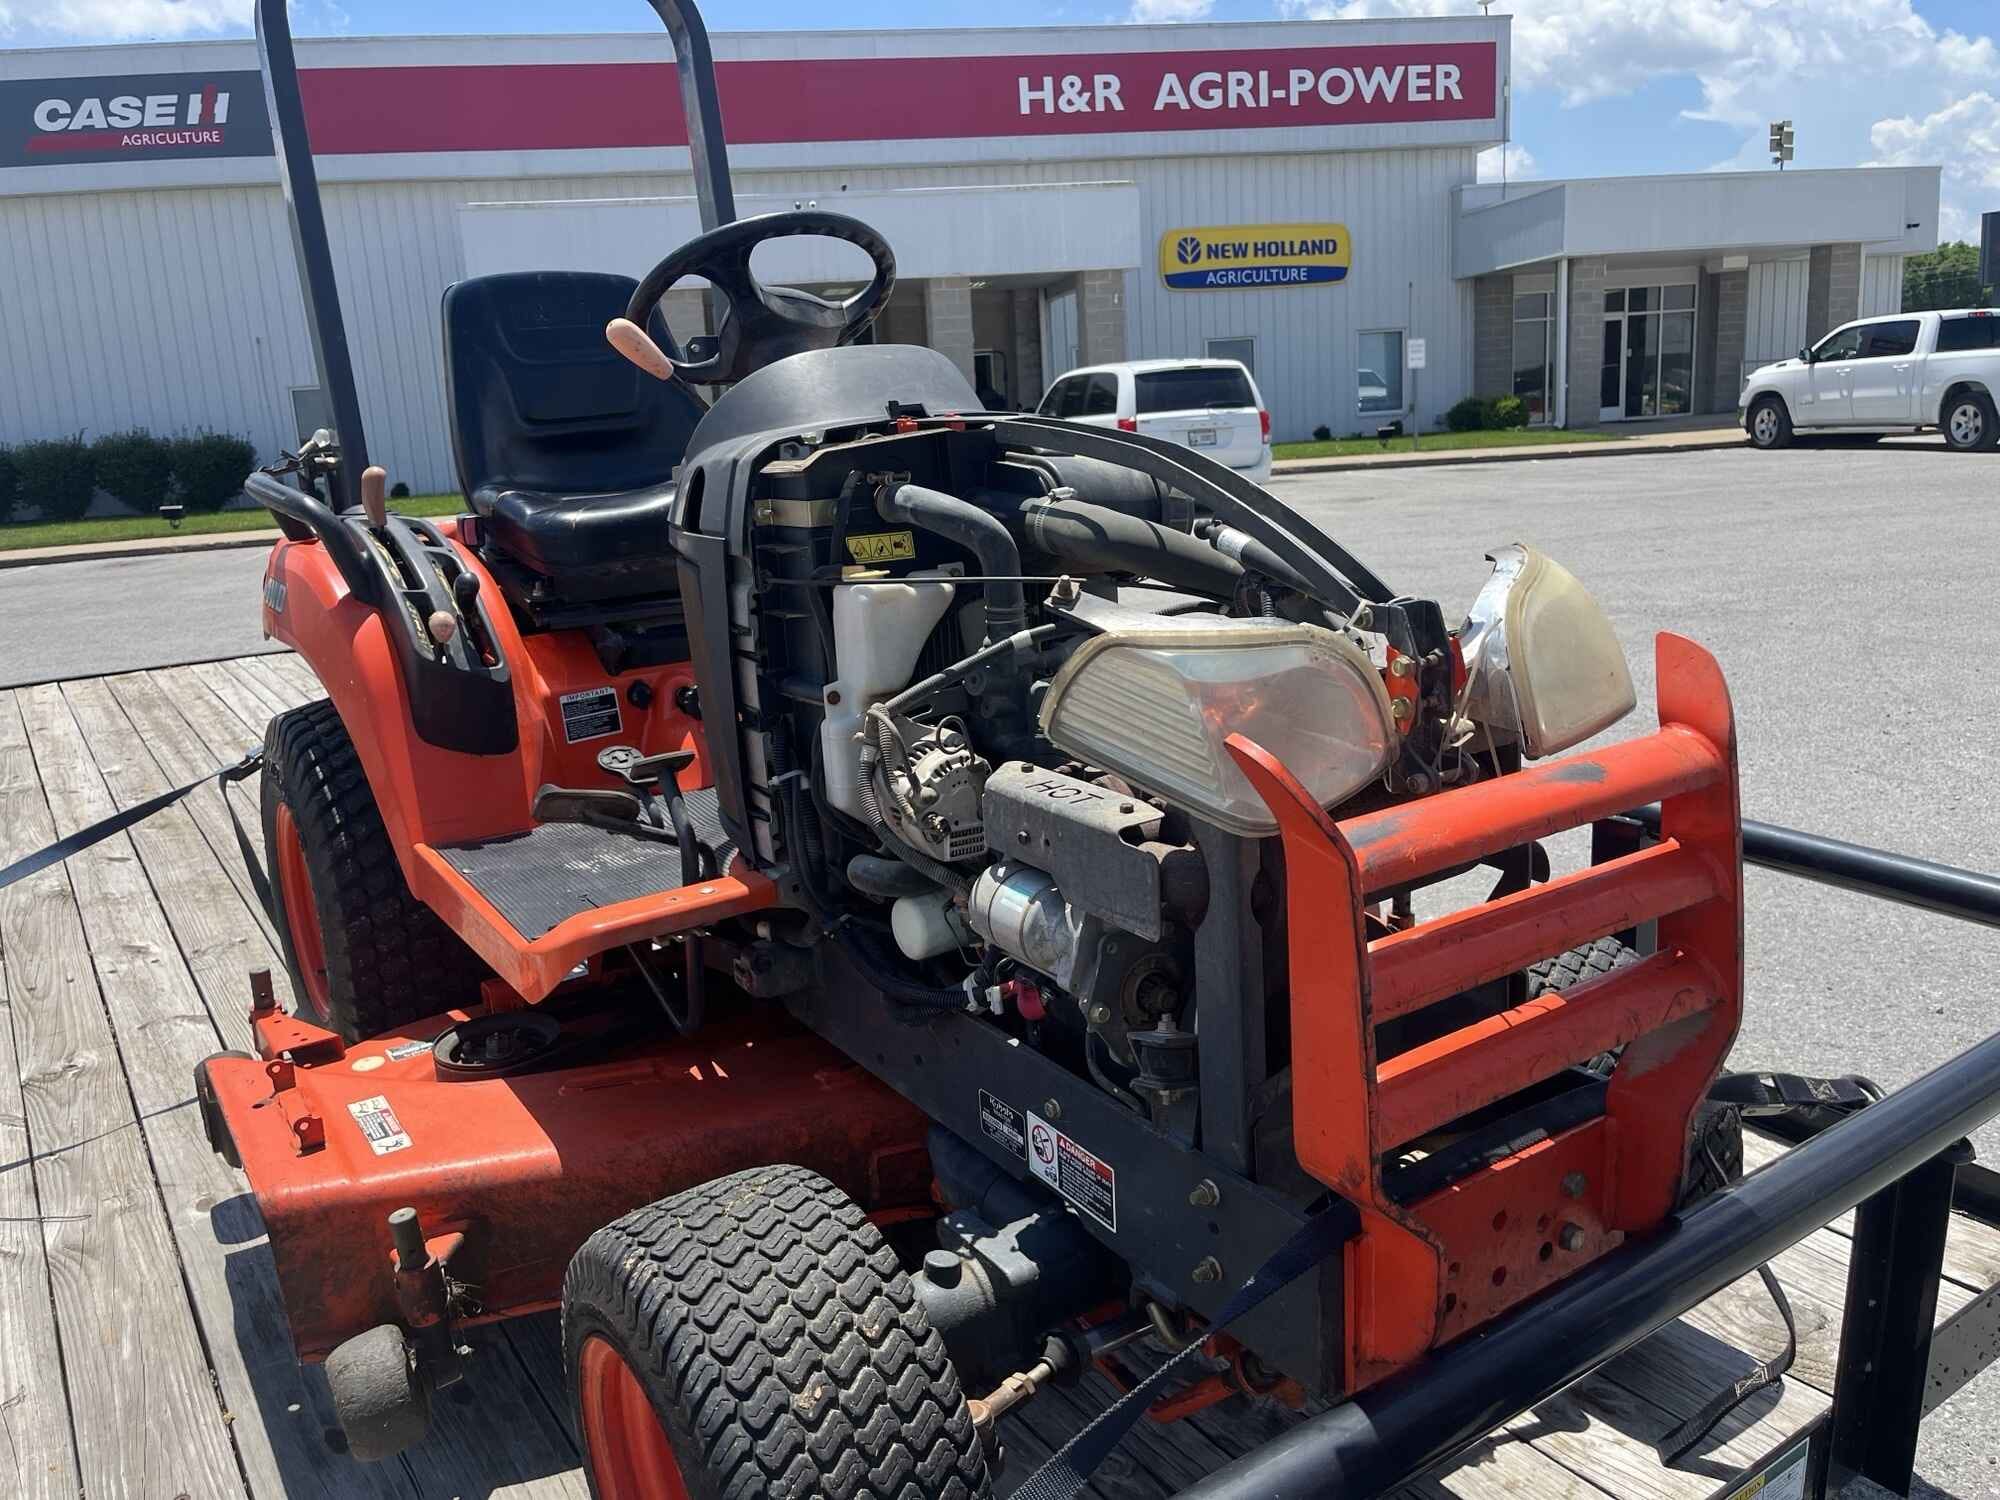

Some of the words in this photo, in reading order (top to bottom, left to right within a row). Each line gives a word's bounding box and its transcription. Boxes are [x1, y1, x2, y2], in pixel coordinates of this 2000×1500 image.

[1018, 73, 1125, 115] H&R
[1153, 63, 1464, 112] AGRI-POWER
[33, 94, 178, 132] CASE
[121, 130, 221, 146] AGRICULTURE
[1206, 241, 1248, 260] NEW
[1253, 238, 1338, 258] HOLLAND
[1206, 268, 1308, 285] AGRICULTURE
[1025, 780, 1105, 804] HOT
[1065, 1141, 1097, 1170] DANGER
